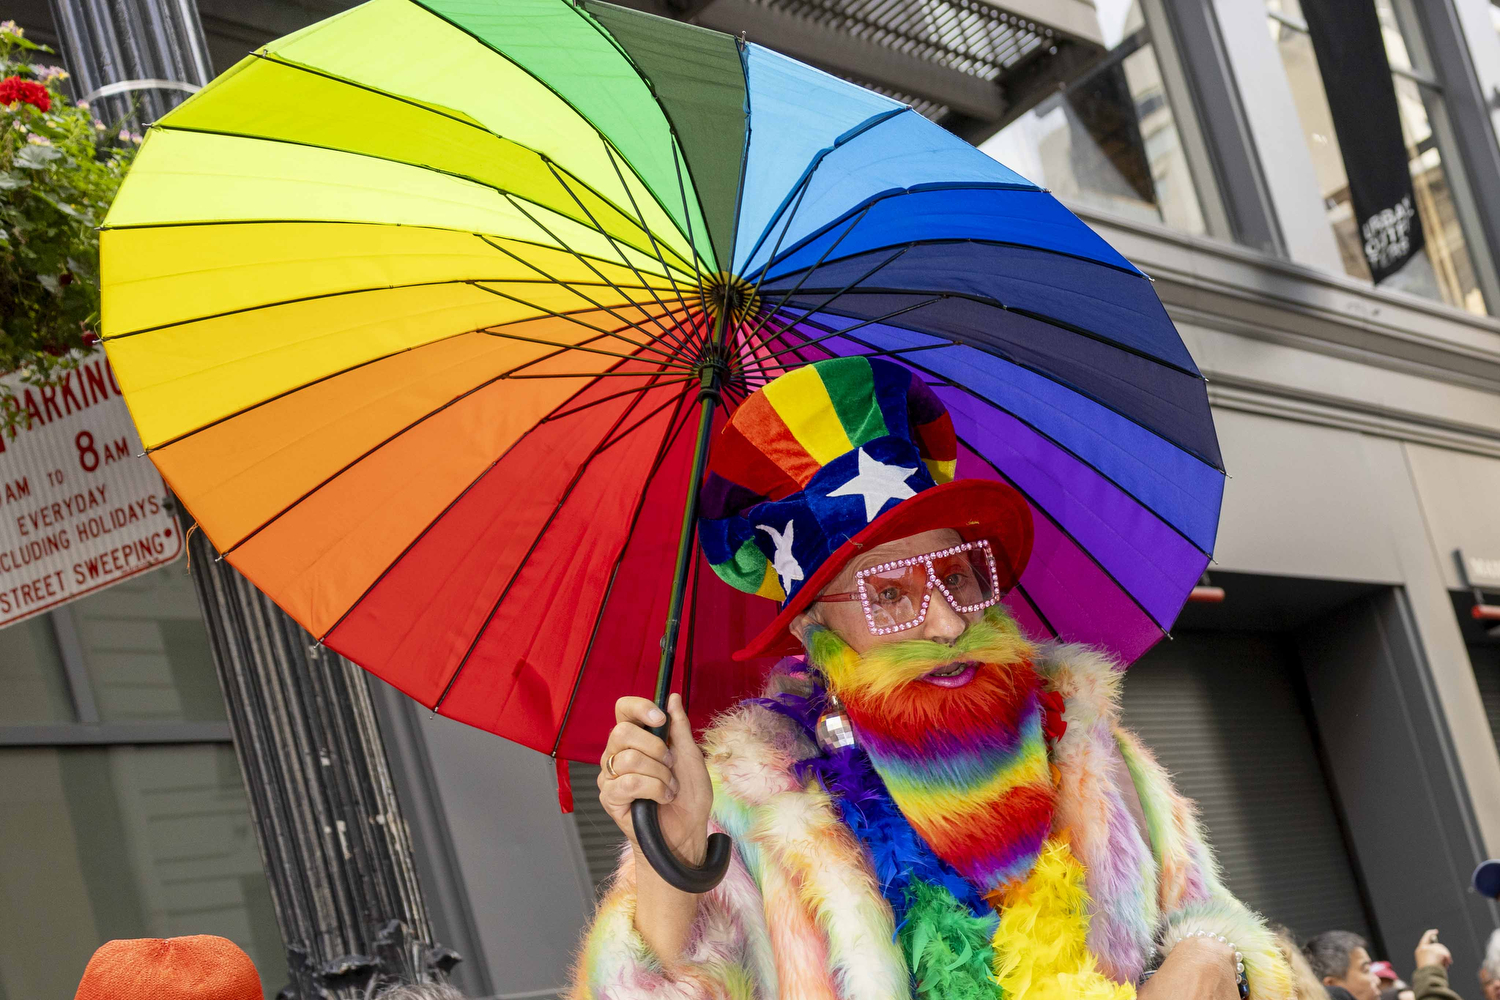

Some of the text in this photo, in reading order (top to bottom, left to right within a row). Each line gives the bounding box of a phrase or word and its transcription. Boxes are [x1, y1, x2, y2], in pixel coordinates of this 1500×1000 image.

[17, 484, 108, 536] EVERYDAY
[47, 469, 64, 487] TO
[0, 530, 70, 574] CLUDING
[76, 495, 160, 543] HOLIDAYS
[1, 532, 164, 614] STREET SWEEPING
